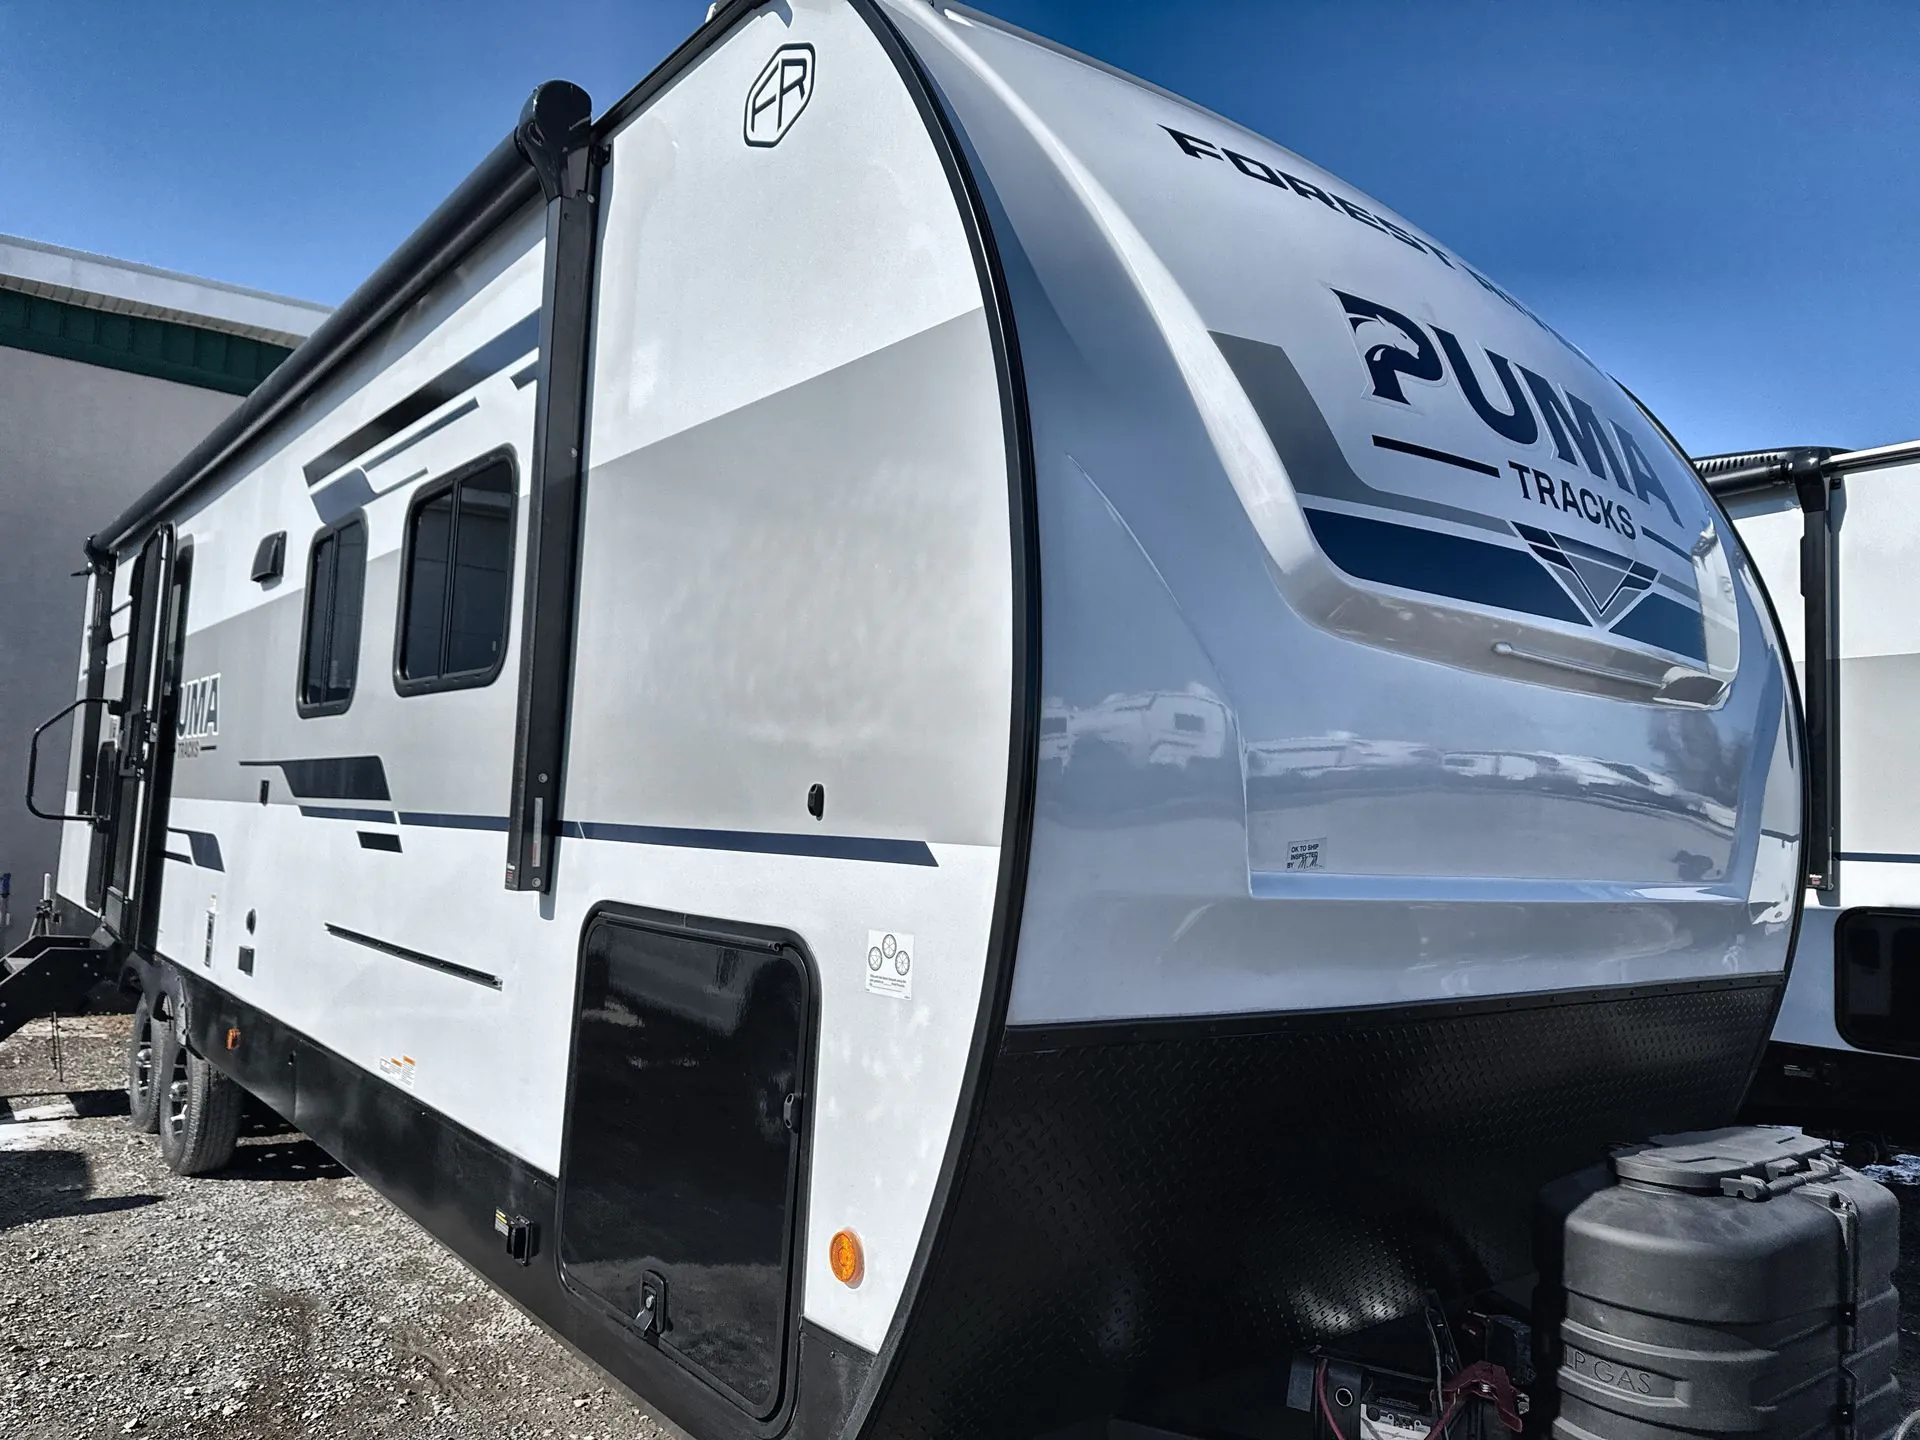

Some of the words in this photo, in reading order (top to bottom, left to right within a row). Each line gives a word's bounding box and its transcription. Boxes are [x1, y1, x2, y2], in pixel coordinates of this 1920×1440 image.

[1156, 122, 1456, 270] FOREST
[1330, 287, 1685, 529] PUMA
[1507, 459, 1637, 540] TRACKS
[176, 672, 221, 740] UMA
[1286, 861, 1295, 869] BY
[1290, 851, 1319, 860] INSPECTED
[1307, 843, 1319, 851] SHIP
[1563, 1344, 1587, 1372] LP
[1594, 1360, 1652, 1394] GAS
